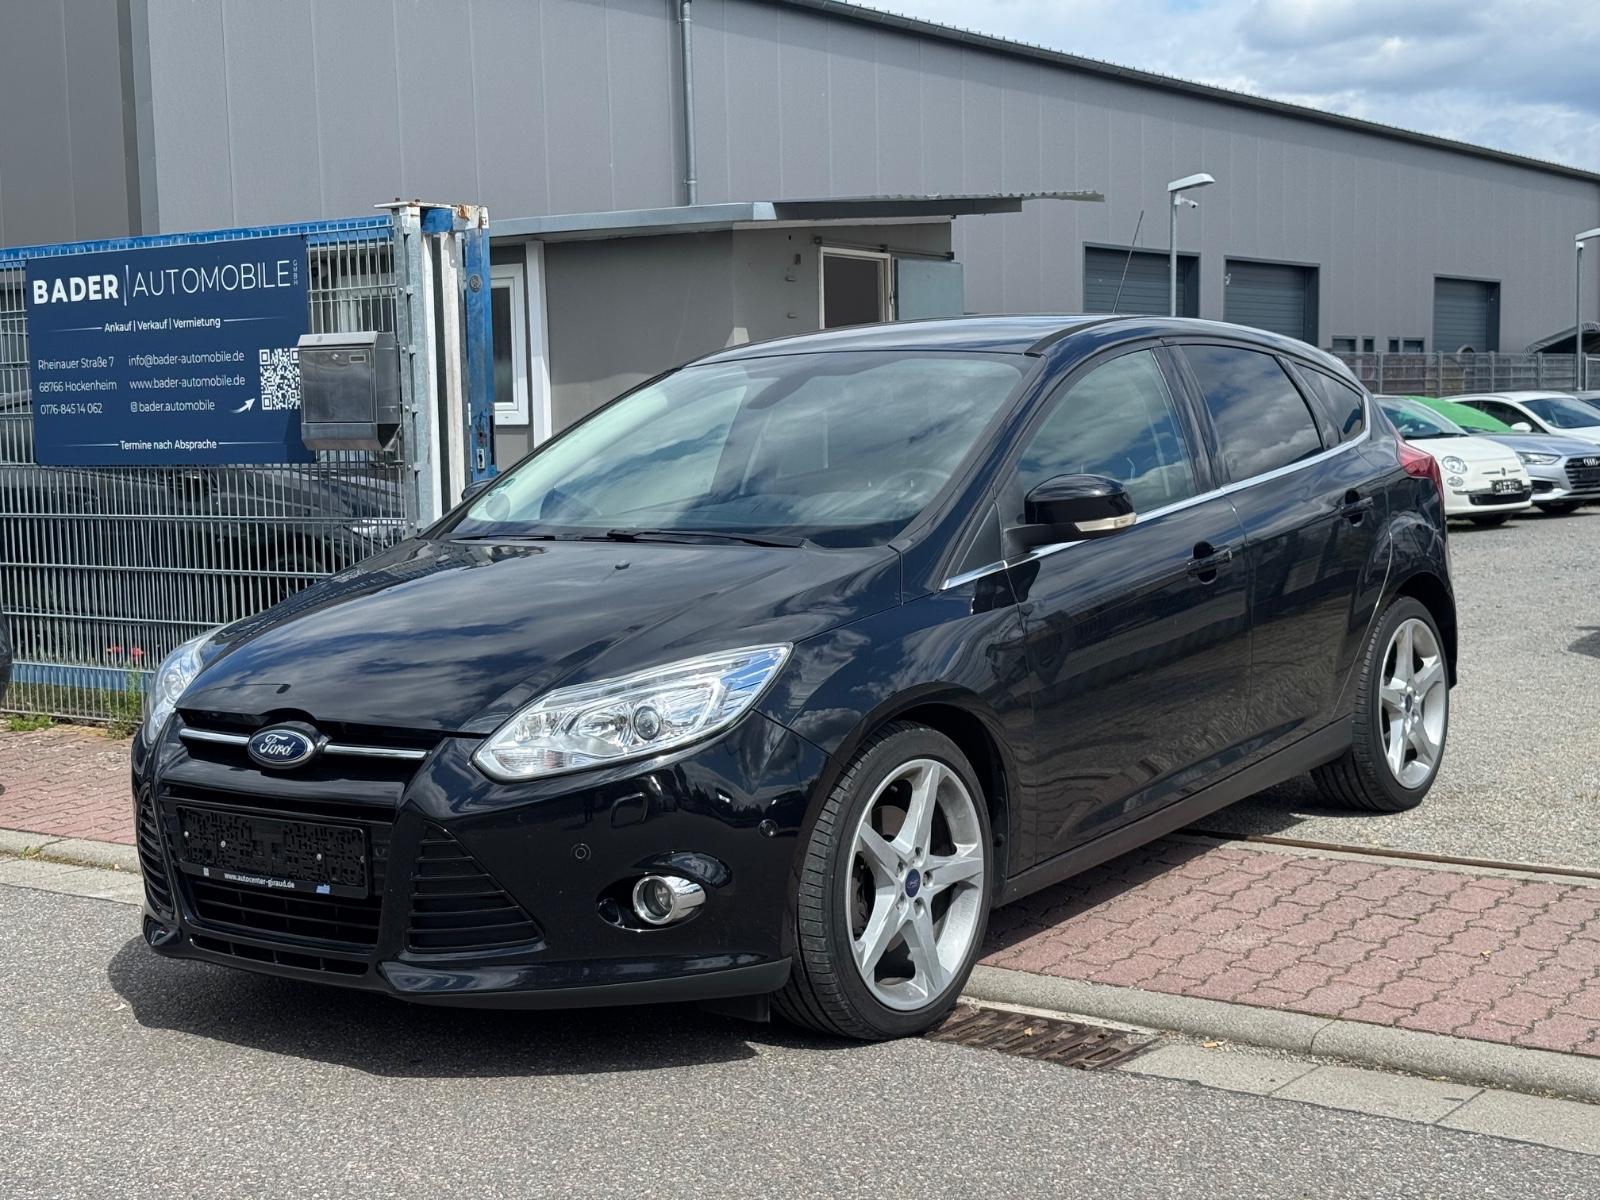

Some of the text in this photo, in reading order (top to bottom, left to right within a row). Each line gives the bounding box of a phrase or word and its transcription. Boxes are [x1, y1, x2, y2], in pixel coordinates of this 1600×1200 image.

[33, 260, 291, 305] BADER AUTOMOBILE
[104, 317, 221, 333] Ankauf Verkauf Vermietung
[38, 356, 115, 370] Rheinauer Straße 7
[128, 350, 245, 368] info@bader-automobile.de
[39, 379, 117, 392] 68766 Hockenheim
[129, 374, 246, 389] www.bader-automobile.de
[87, 402, 103, 414] 062
[120, 437, 217, 450] Termine nach Absprache
[259, 733, 296, 756] Ford
